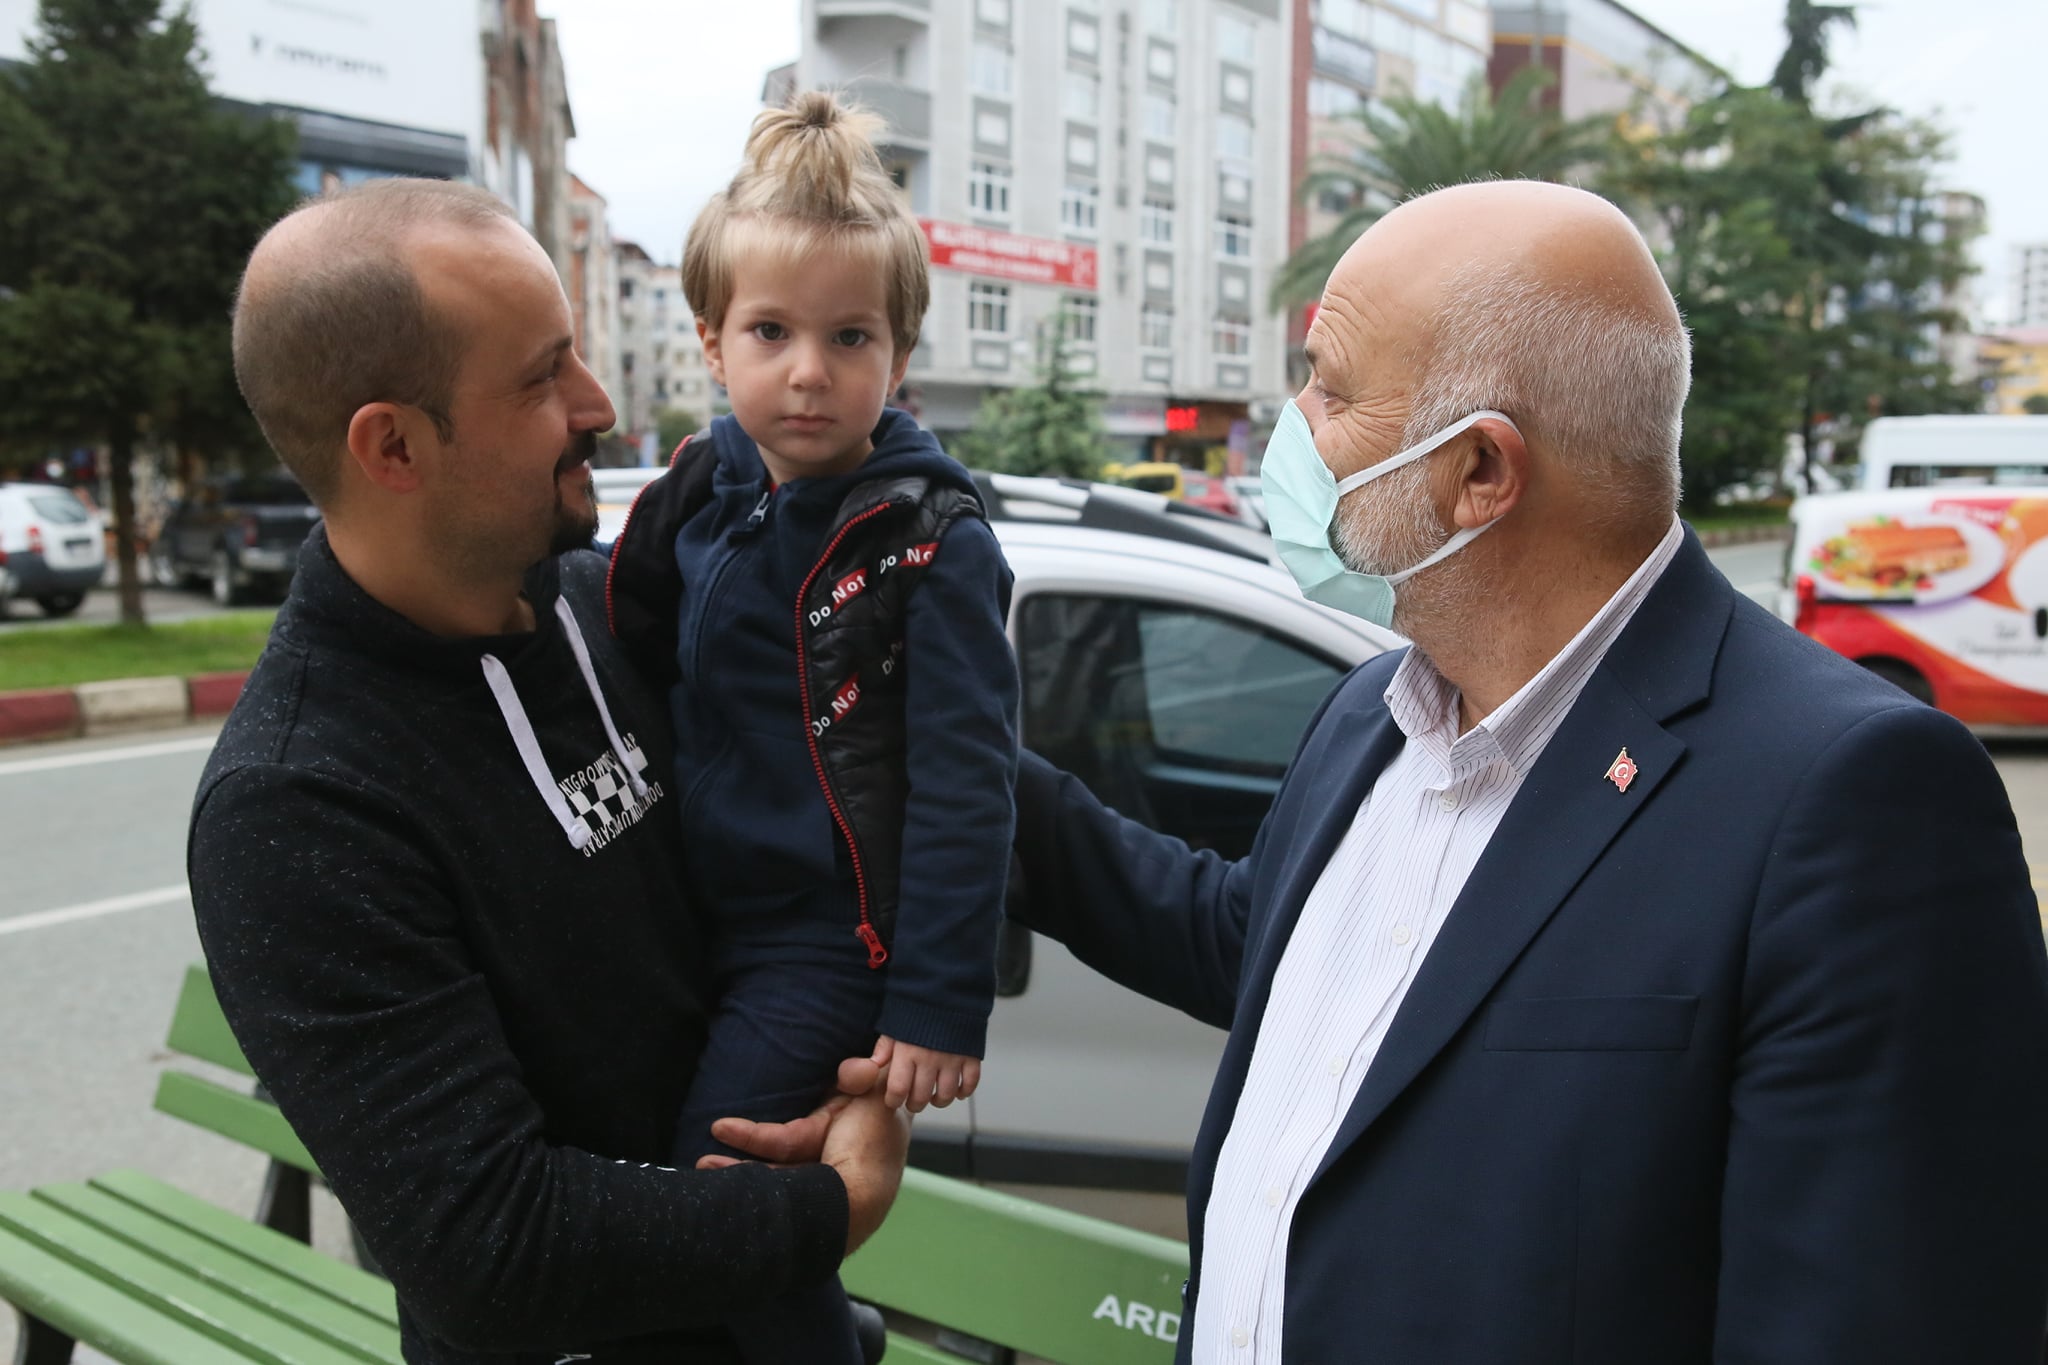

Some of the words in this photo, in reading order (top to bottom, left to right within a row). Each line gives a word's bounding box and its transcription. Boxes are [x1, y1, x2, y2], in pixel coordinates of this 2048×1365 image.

[906, 548, 933, 563] No
[809, 606, 831, 627] Do
[832, 575, 866, 603] Not
[812, 716, 830, 736] Do
[831, 683, 861, 714] Not
[1093, 1294, 1182, 1343] ARD
